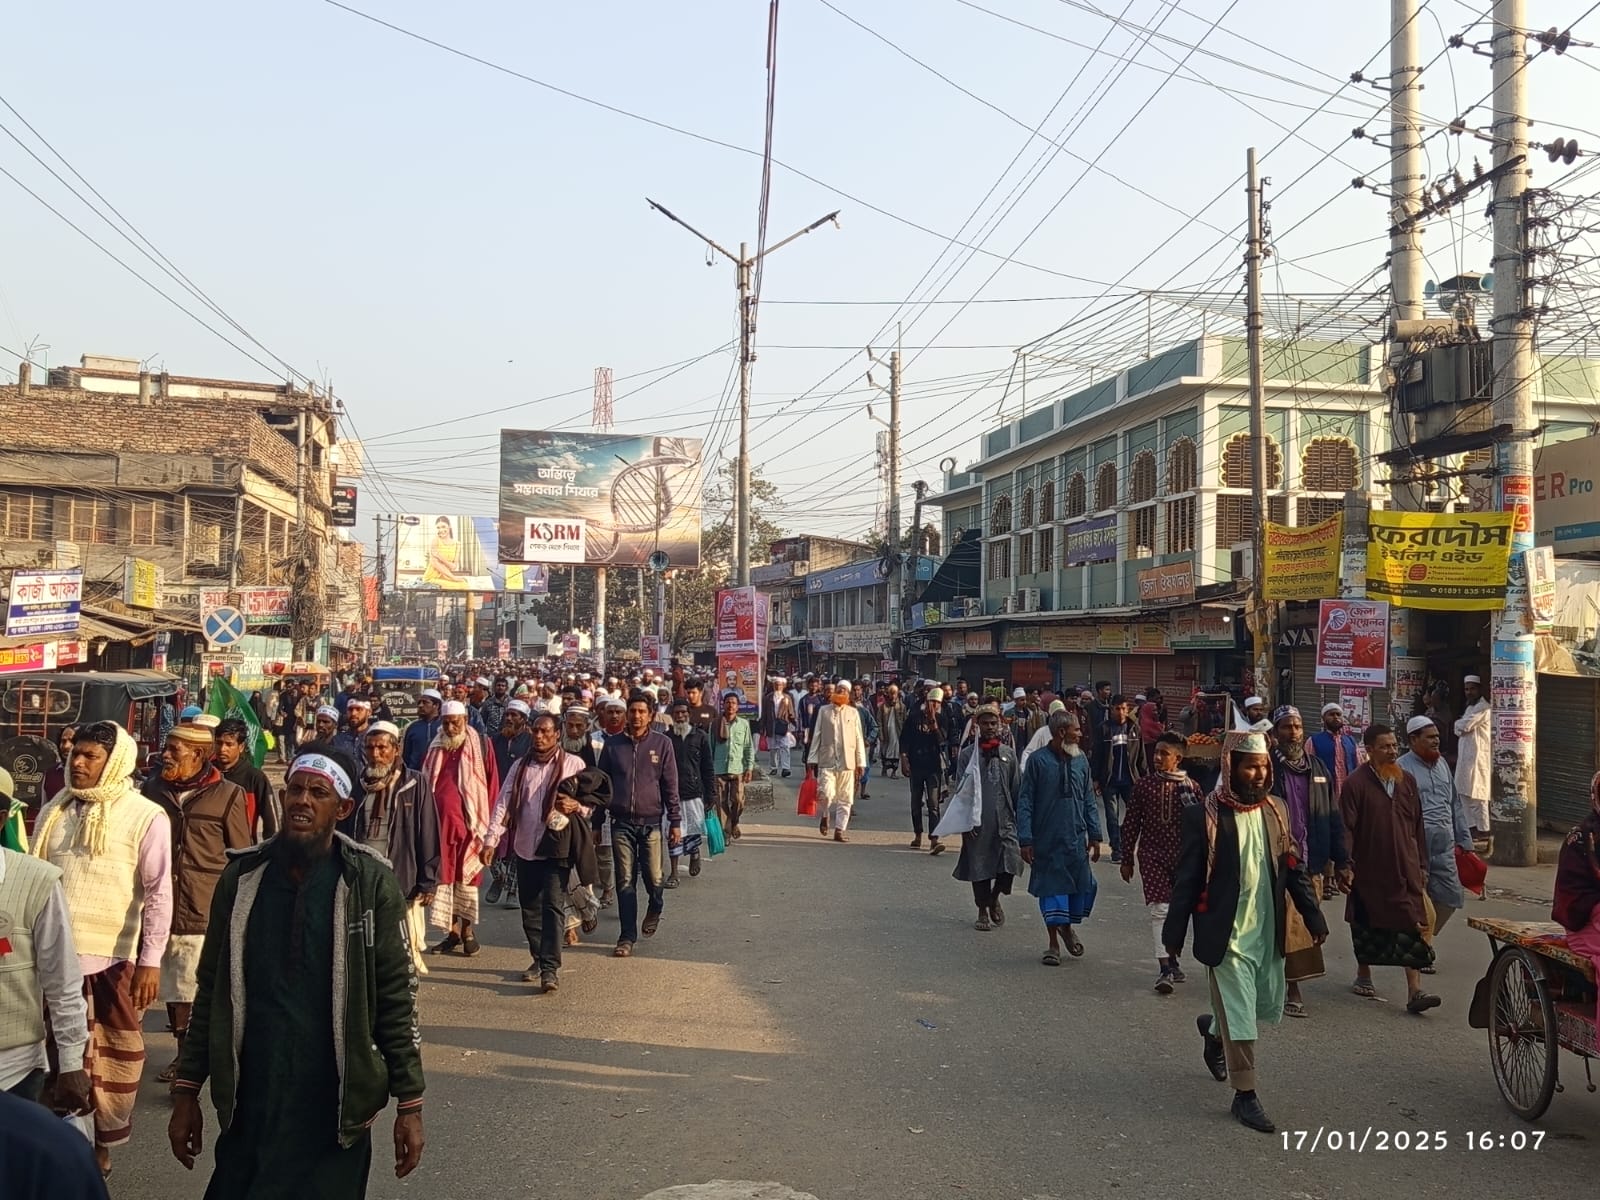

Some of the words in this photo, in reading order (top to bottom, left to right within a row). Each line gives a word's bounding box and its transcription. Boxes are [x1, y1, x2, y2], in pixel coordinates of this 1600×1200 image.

[537, 465, 576, 483] অস্তিত্বে
[513, 483, 562, 497] সম্ভাবনার
[565, 483, 599, 498] শিখরে
[1569, 479, 1593, 495] Pro
[530, 522, 580, 543] KSRM
[1382, 545, 1436, 561] ইংলিশ
[1440, 549, 1484, 563] এইড
[17, 577, 46, 602] কাজী
[49, 576, 80, 600] অফিস
[1350, 607, 1376, 617] জেলা
[1348, 618, 1386, 628] সম্মেলন
